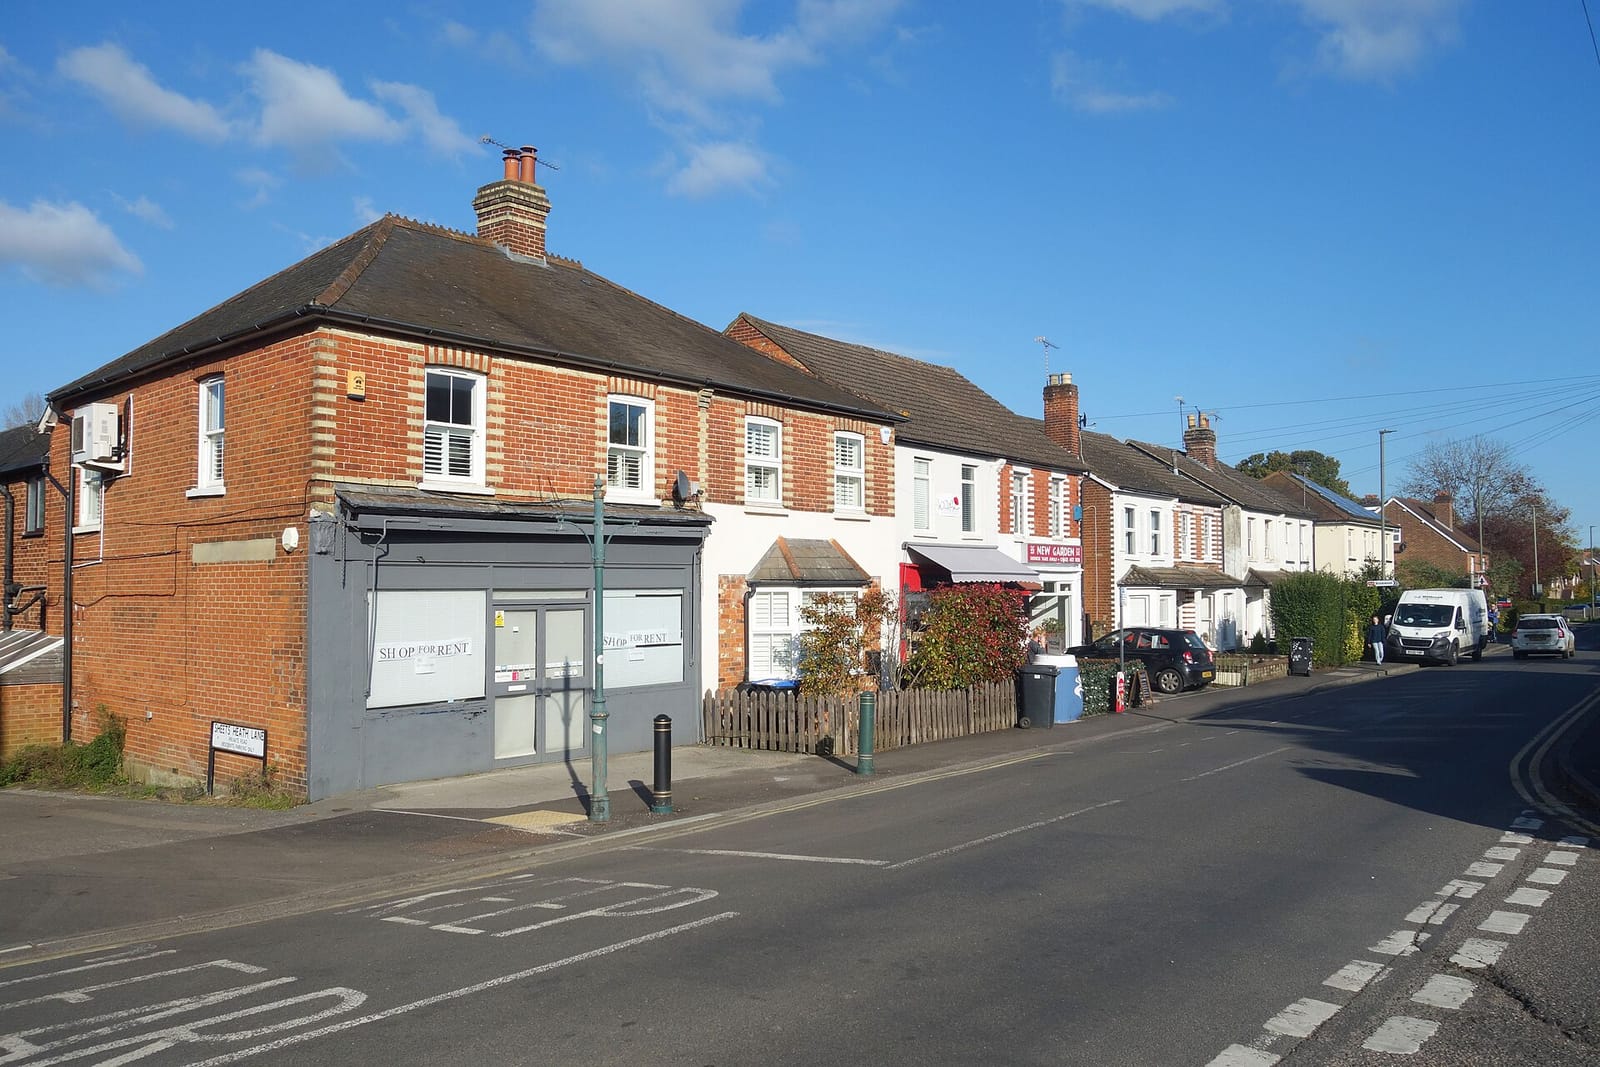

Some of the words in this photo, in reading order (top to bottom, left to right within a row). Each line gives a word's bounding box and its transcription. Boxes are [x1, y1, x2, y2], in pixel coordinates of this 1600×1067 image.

[1037, 545, 1050, 555] NEW
[1053, 546, 1074, 556] GARDEN
[603, 636, 628, 647] SHOP
[630, 634, 643, 642] FOR
[644, 632, 667, 644] RENT
[379, 647, 415, 660] SHOP
[418, 645, 436, 654] FOR
[437, 642, 469, 656] RENT
[233, 727, 249, 739] HEATH
[251, 731, 264, 741] LANE
